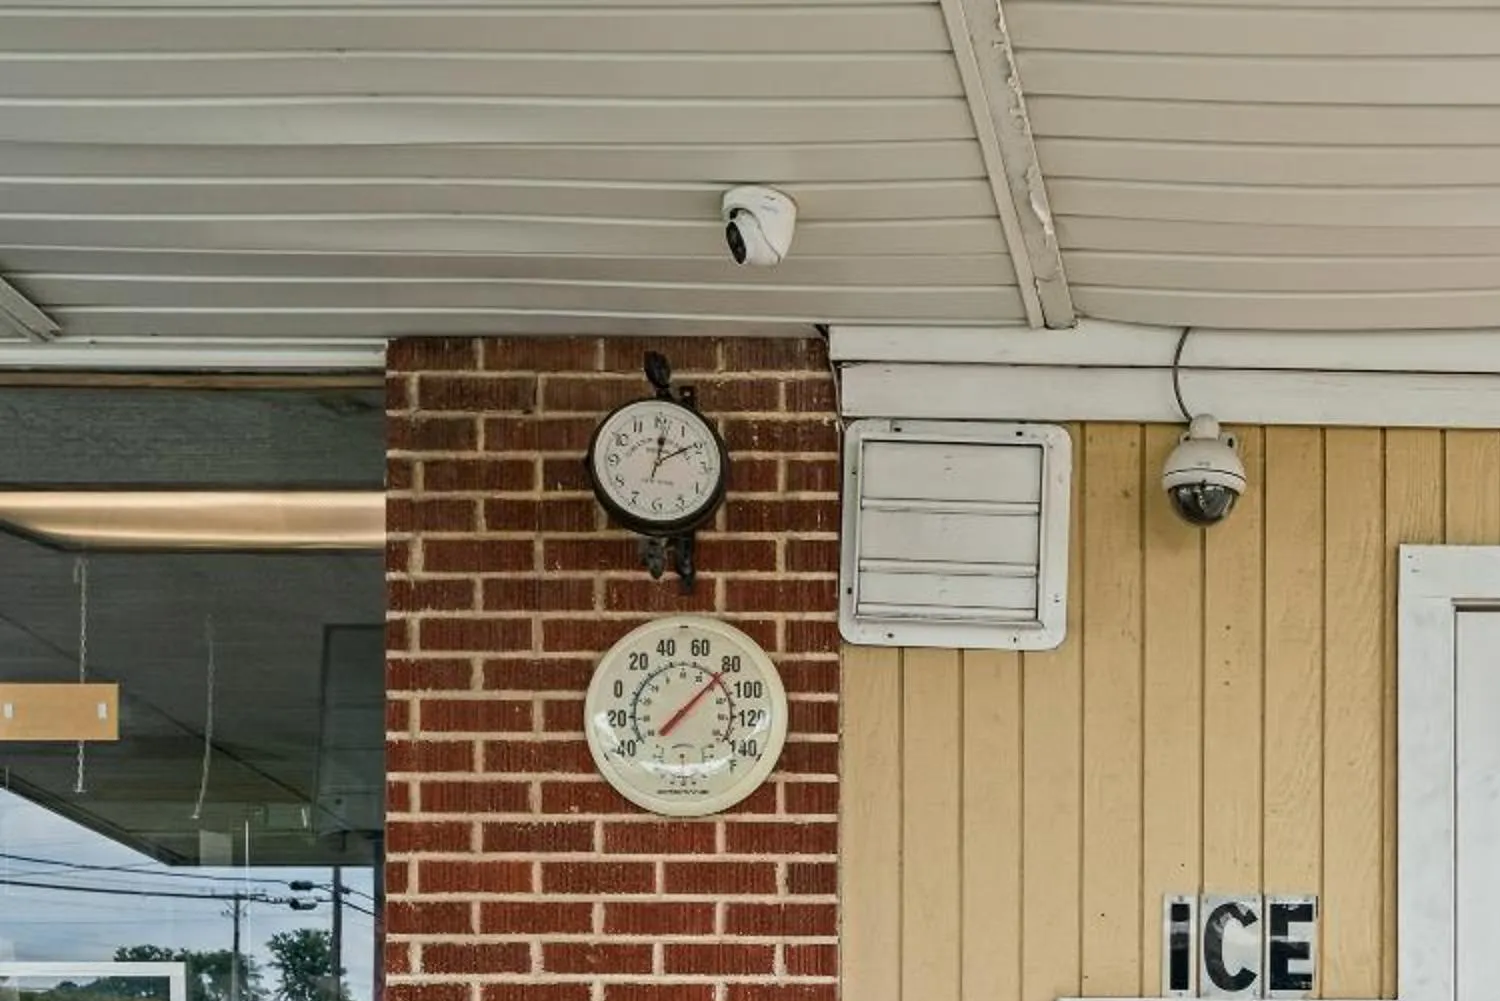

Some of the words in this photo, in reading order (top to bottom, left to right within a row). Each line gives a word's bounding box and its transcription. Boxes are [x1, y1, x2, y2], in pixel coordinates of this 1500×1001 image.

[657, 639, 675, 656] 40
[691, 639, 710, 656] 60
[629, 652, 648, 671] 20
[721, 656, 740, 672] 80
[614, 679, 623, 698] 0
[734, 681, 762, 698] 100
[608, 709, 627, 727] 20
[730, 739, 757, 756] 140
[1170, 902, 1313, 992] ICE
